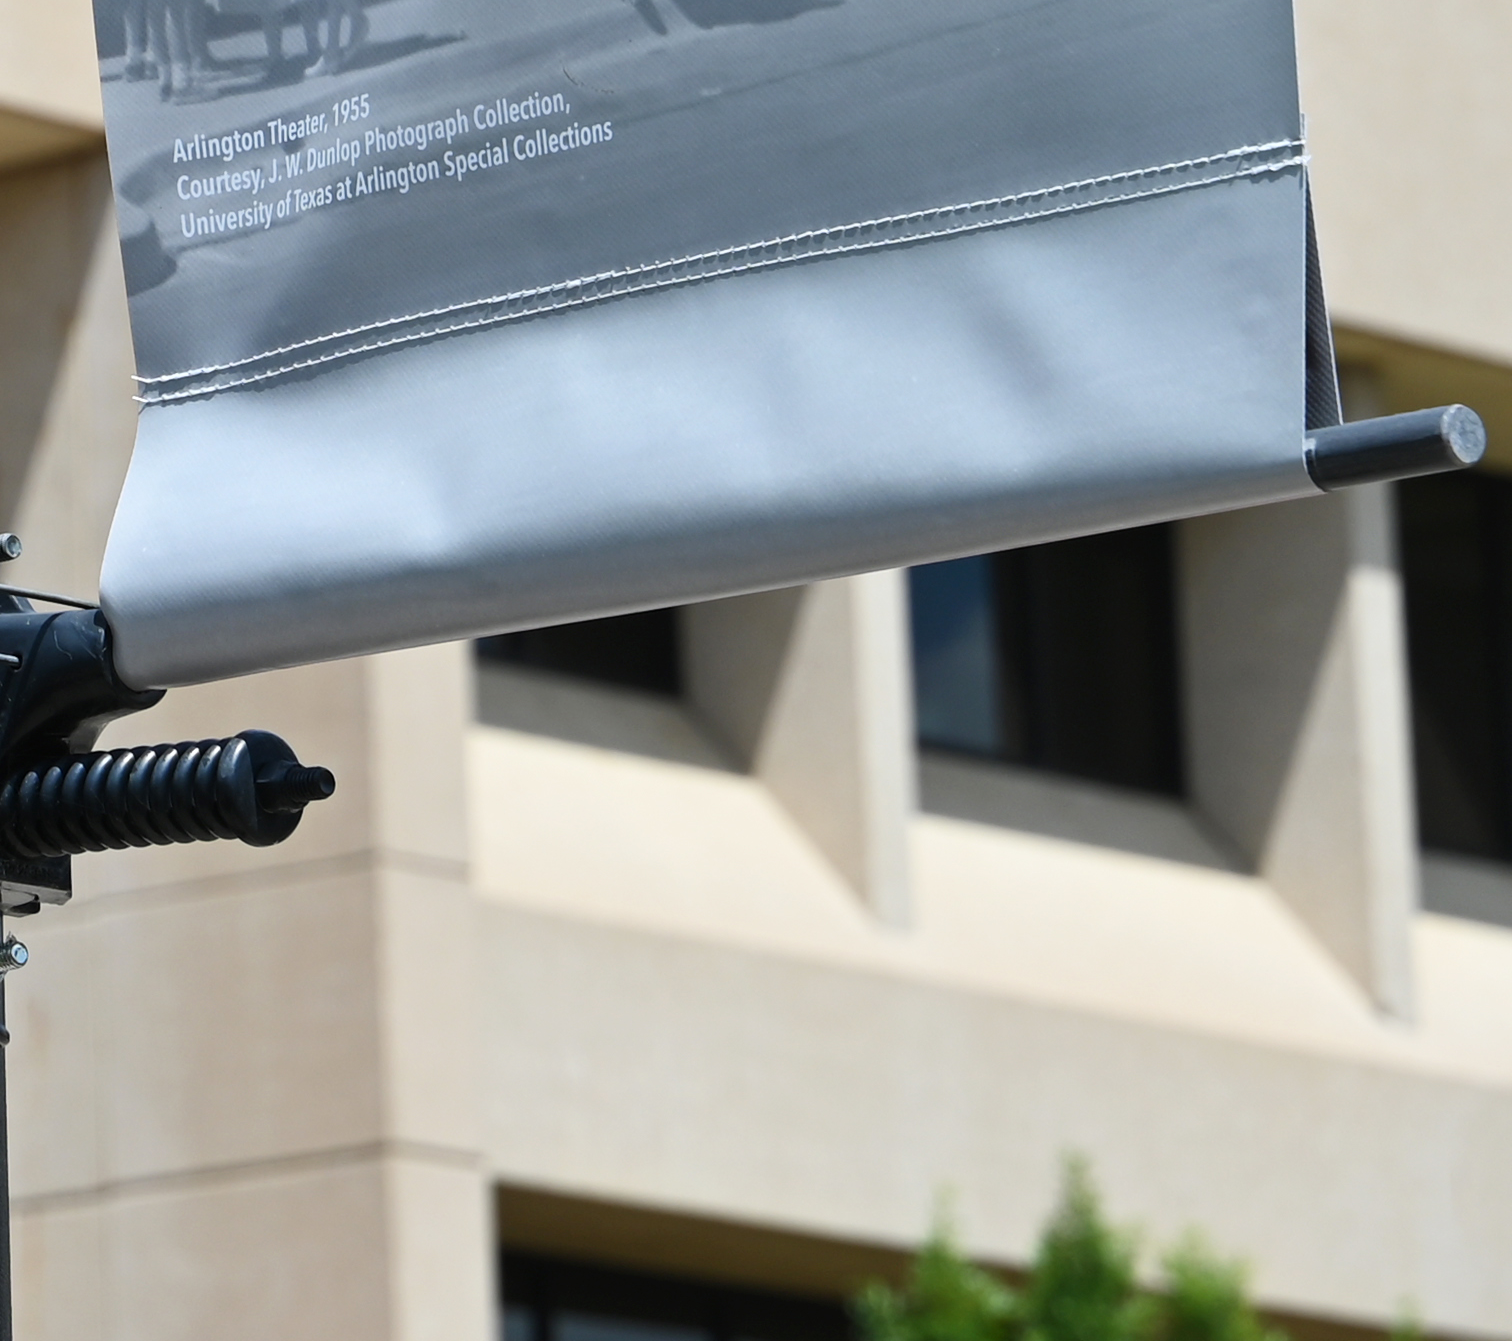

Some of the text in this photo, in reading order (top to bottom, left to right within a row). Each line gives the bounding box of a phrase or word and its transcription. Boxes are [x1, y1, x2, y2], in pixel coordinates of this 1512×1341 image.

[172, 93, 370, 163] Arlington Theater, 1955
[176, 91, 571, 200] Courtesy, J. W. Dunlop Photograph Collection,
[179, 120, 613, 238] University of Texas at Arlington Special Collections
